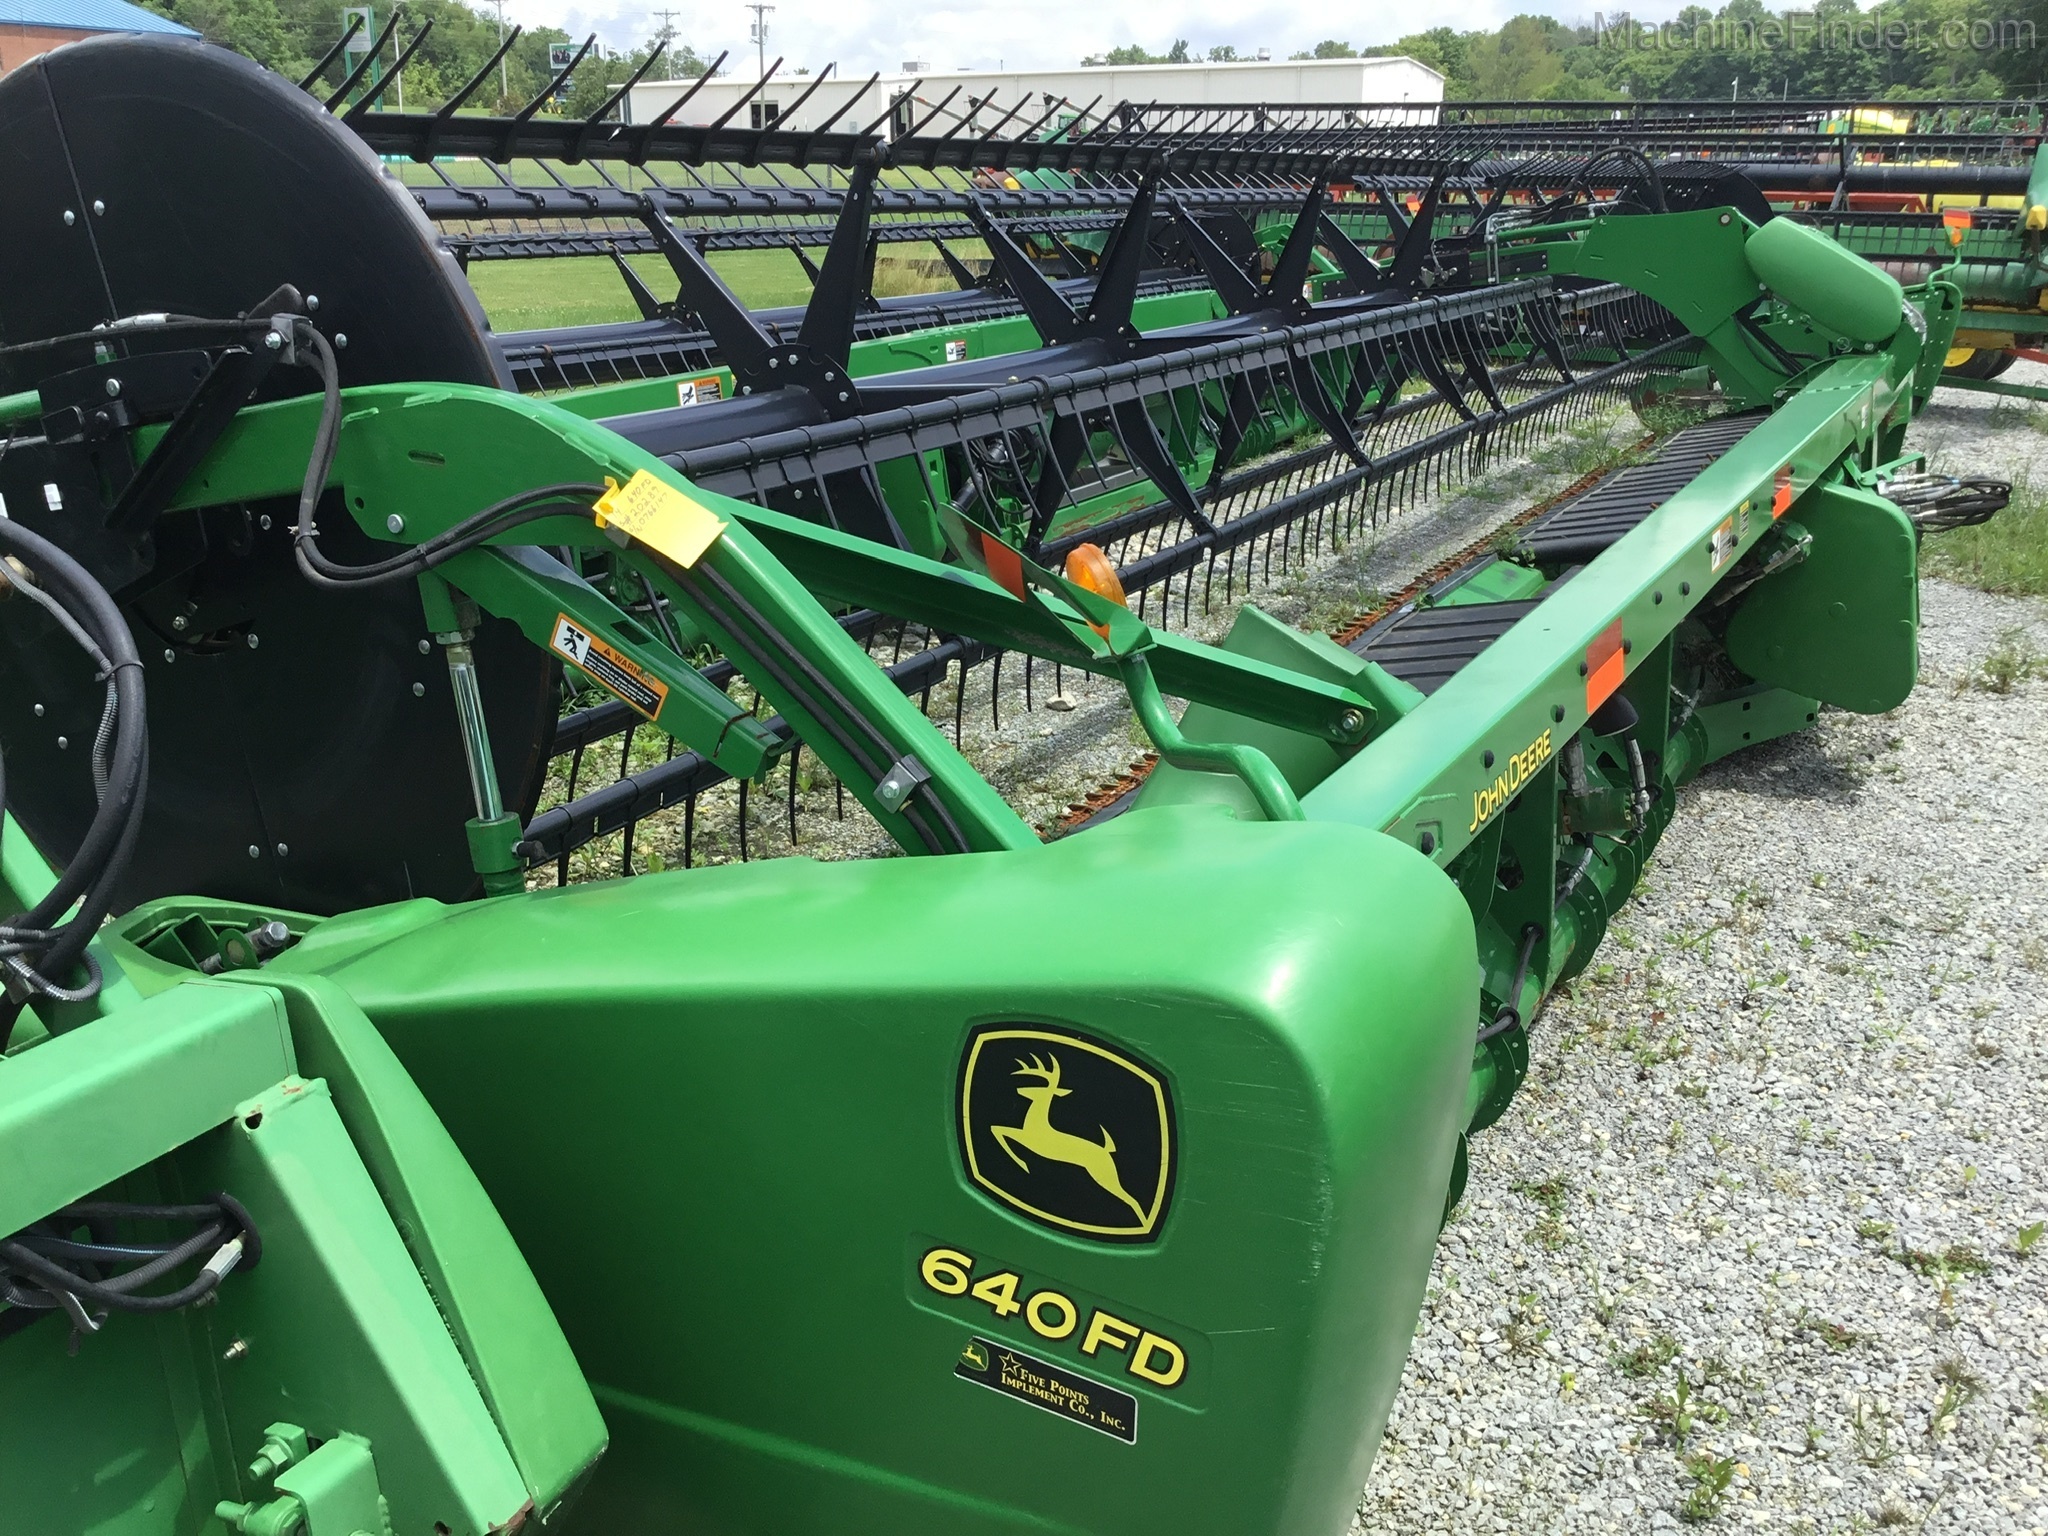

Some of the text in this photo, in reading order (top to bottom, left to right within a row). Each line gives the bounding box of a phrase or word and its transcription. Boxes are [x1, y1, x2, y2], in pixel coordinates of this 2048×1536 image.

[1469, 727, 1552, 834] JOHN DEERE
[920, 1248, 1187, 1387] 640 FD
